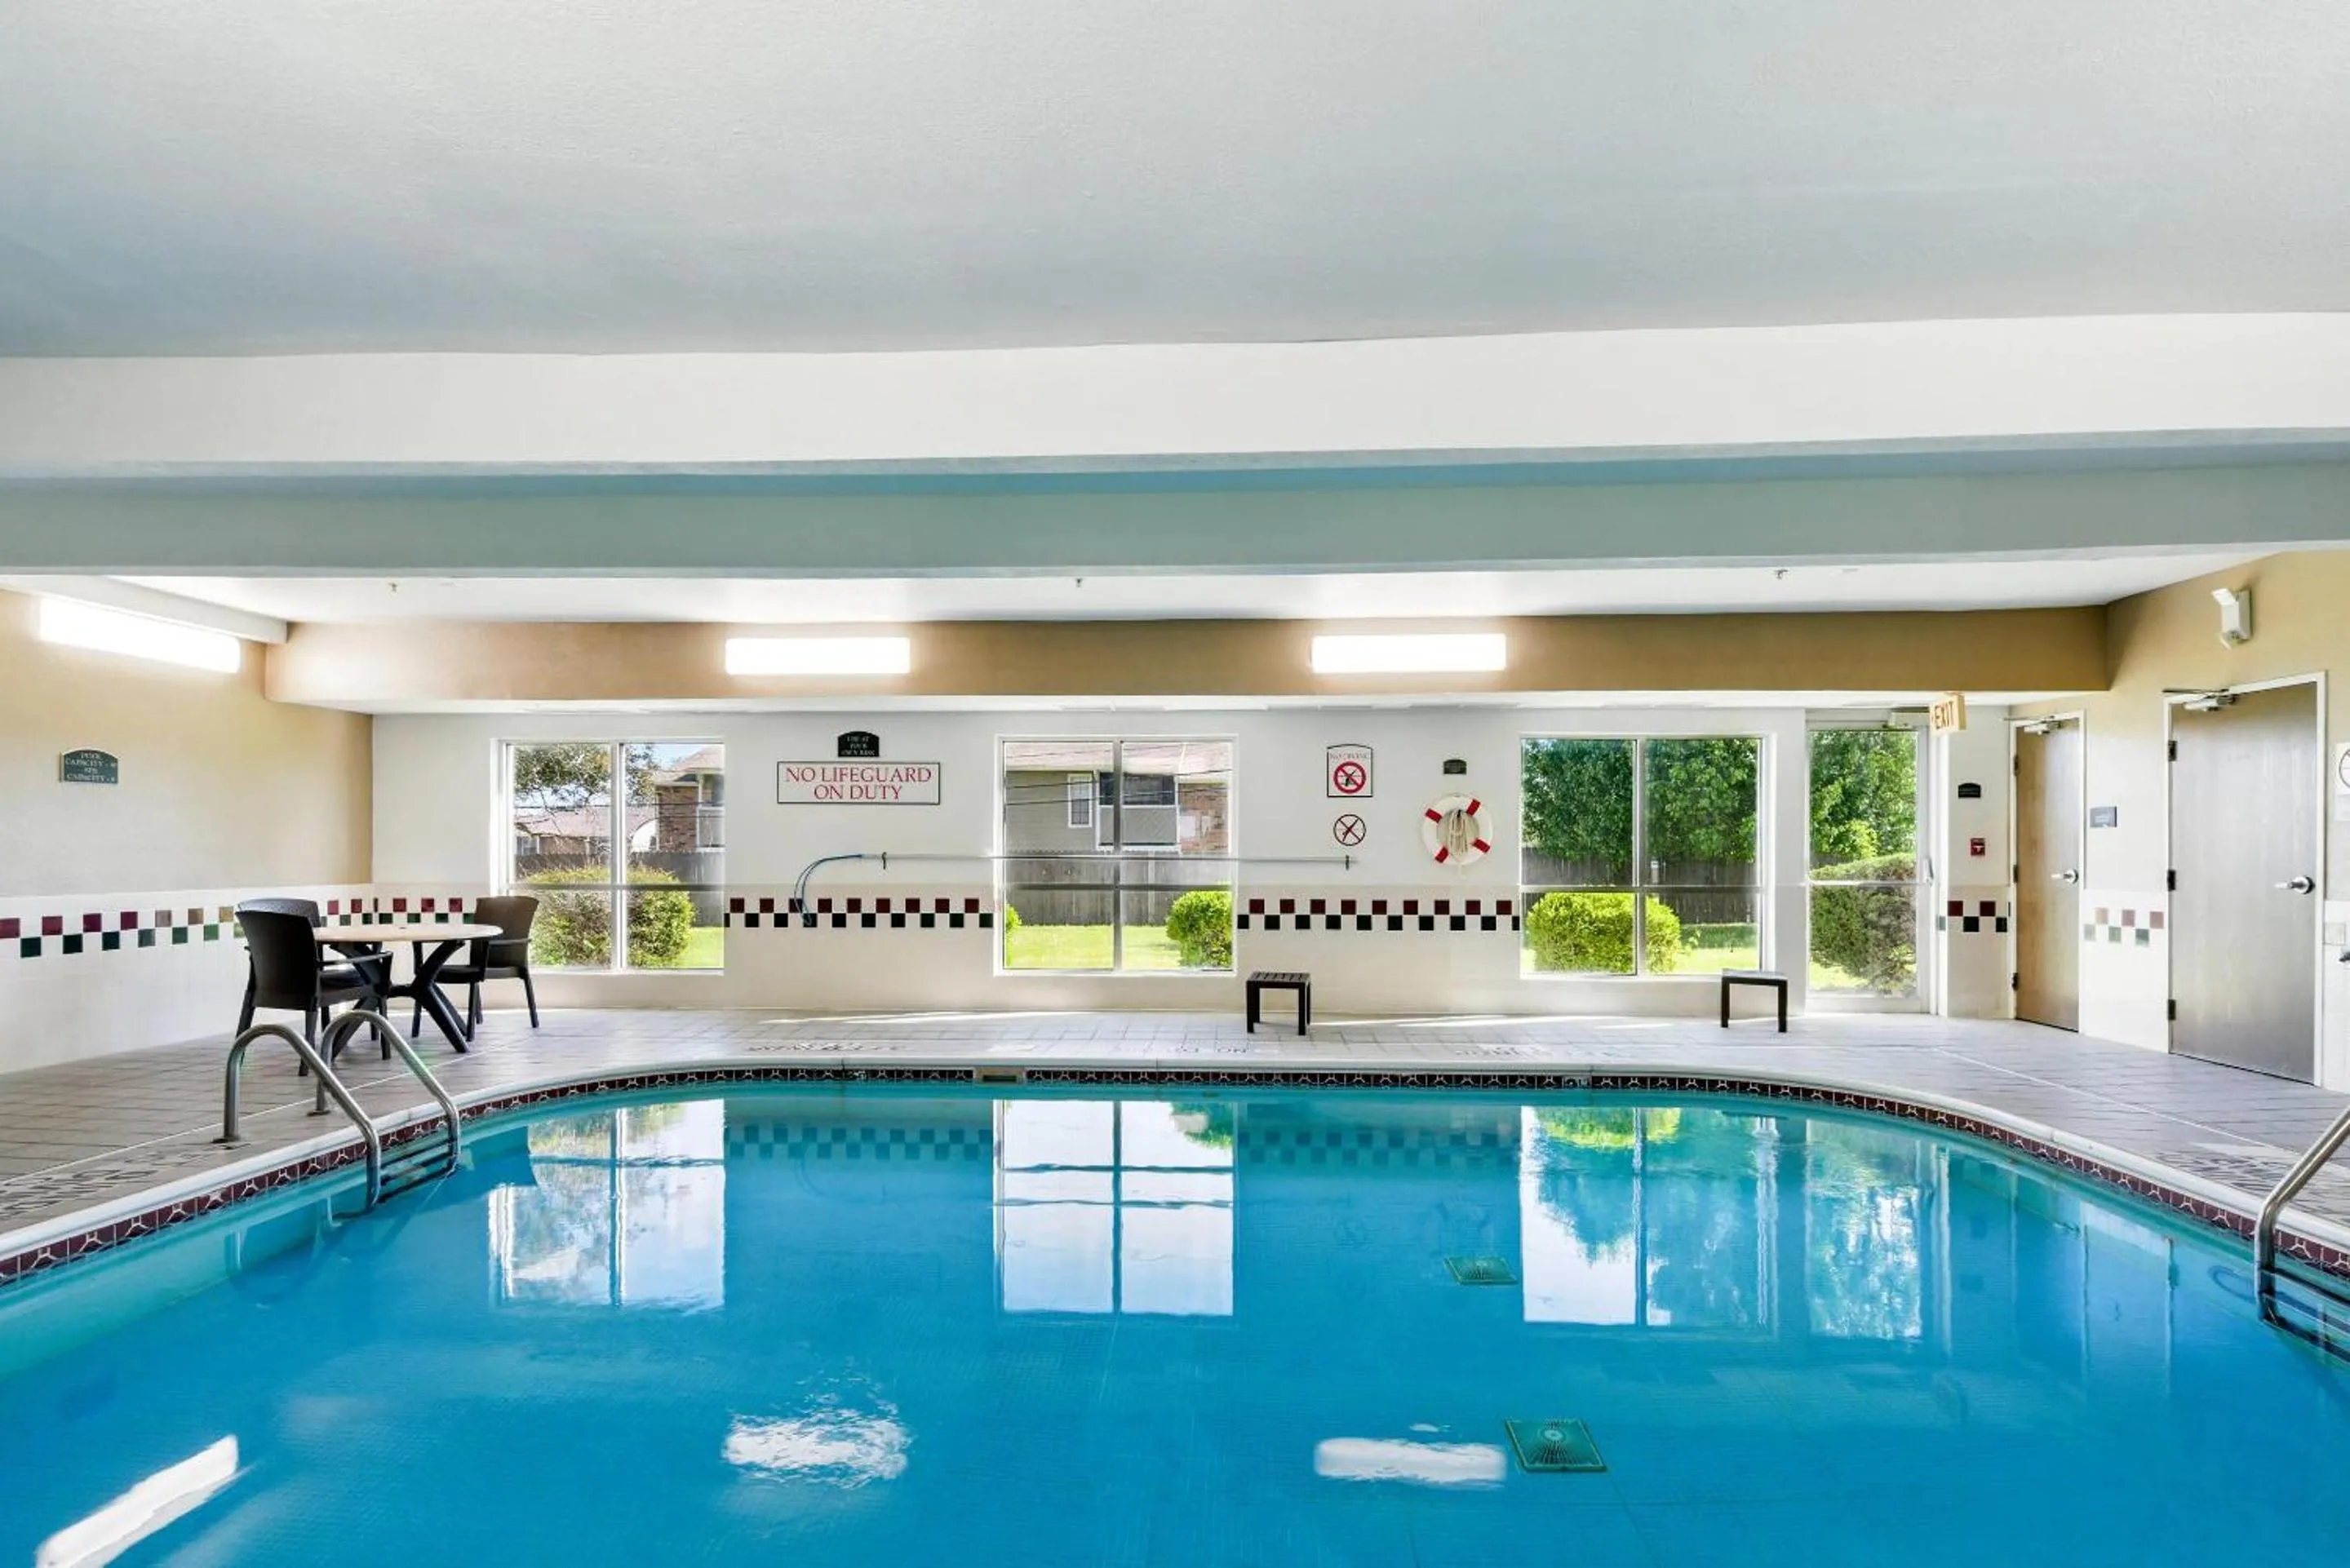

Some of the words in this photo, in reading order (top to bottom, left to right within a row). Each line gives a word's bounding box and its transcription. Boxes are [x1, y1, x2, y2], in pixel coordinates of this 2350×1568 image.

[1934, 701, 1954, 730] EXIT
[64, 757, 104, 767] CAPACITY
[786, 767, 816, 783] NO
[821, 767, 932, 783] LIFEGUARD
[814, 784, 845, 800] ON
[849, 784, 903, 800] DUTY
